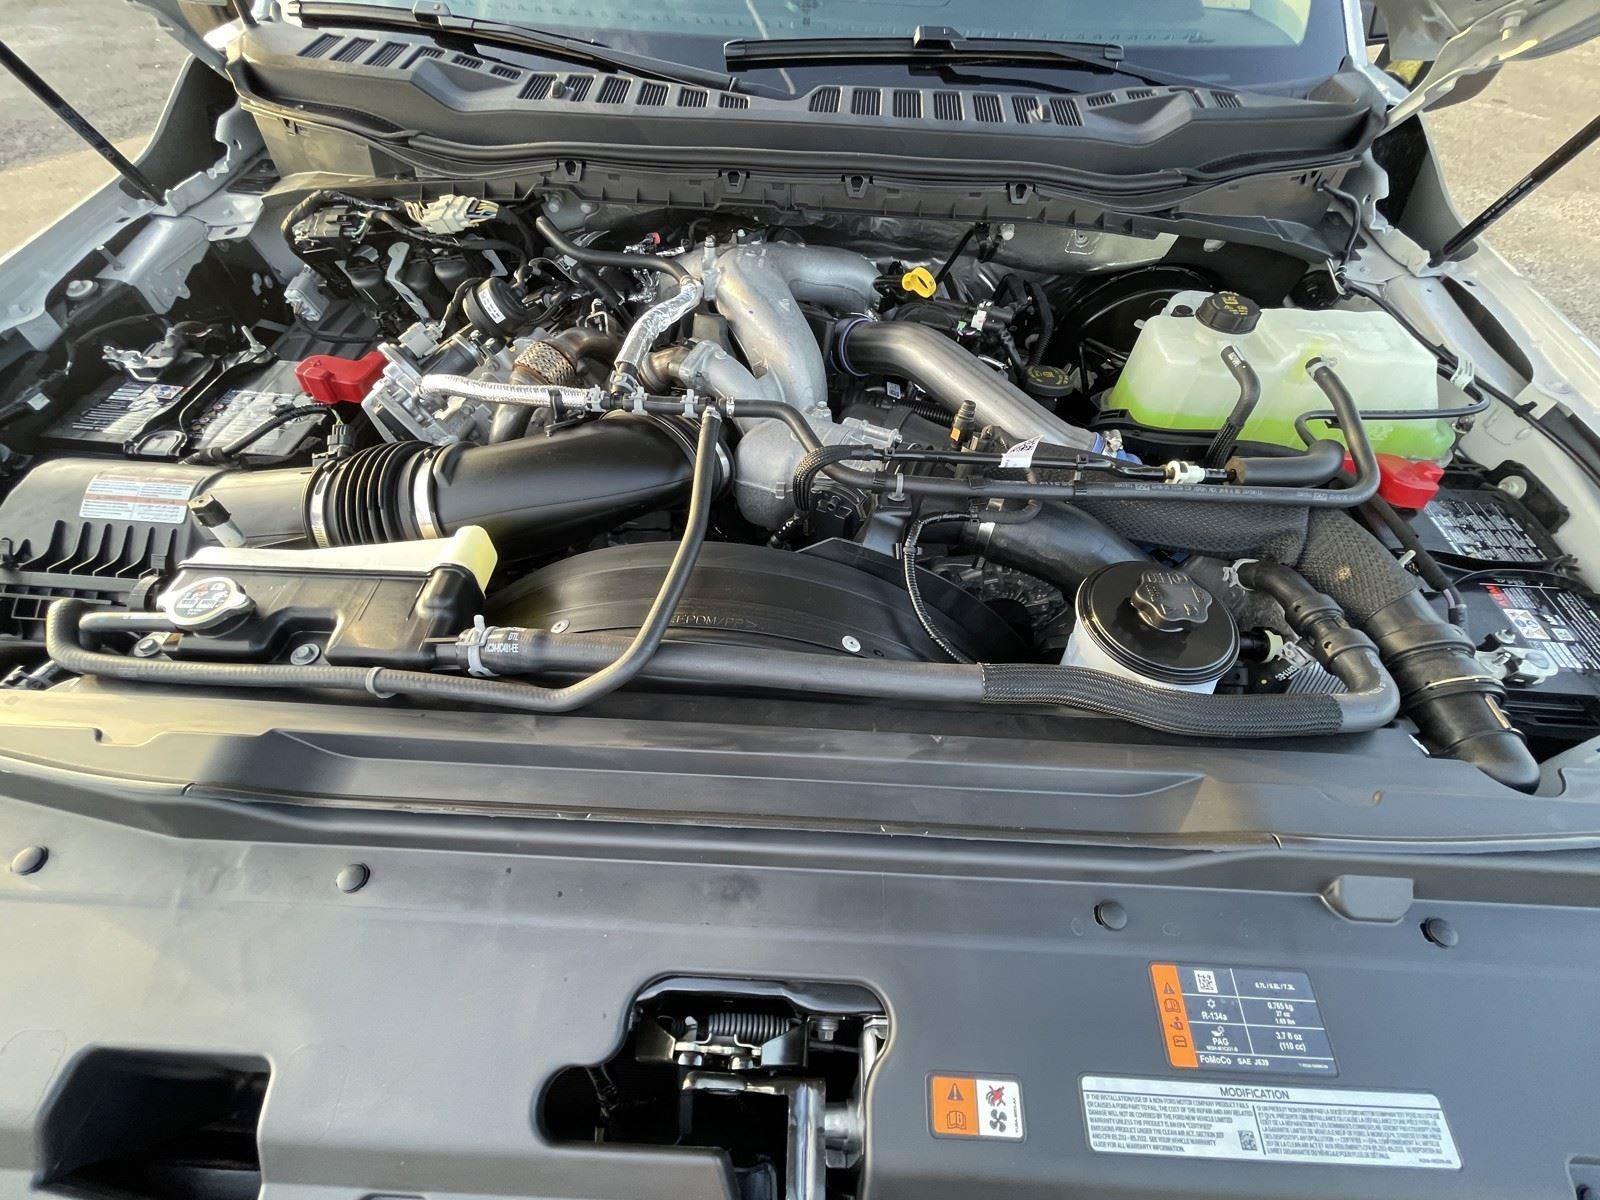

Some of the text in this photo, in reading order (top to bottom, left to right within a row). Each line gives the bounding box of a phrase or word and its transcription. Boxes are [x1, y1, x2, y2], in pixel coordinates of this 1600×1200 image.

[1201, 1011, 1228, 1021] R-134a
[1212, 1037, 1230, 1047] PAG
[1200, 1054, 1232, 1066] FoMoCo
[1220, 1087, 1290, 1100] MODIFICATION
